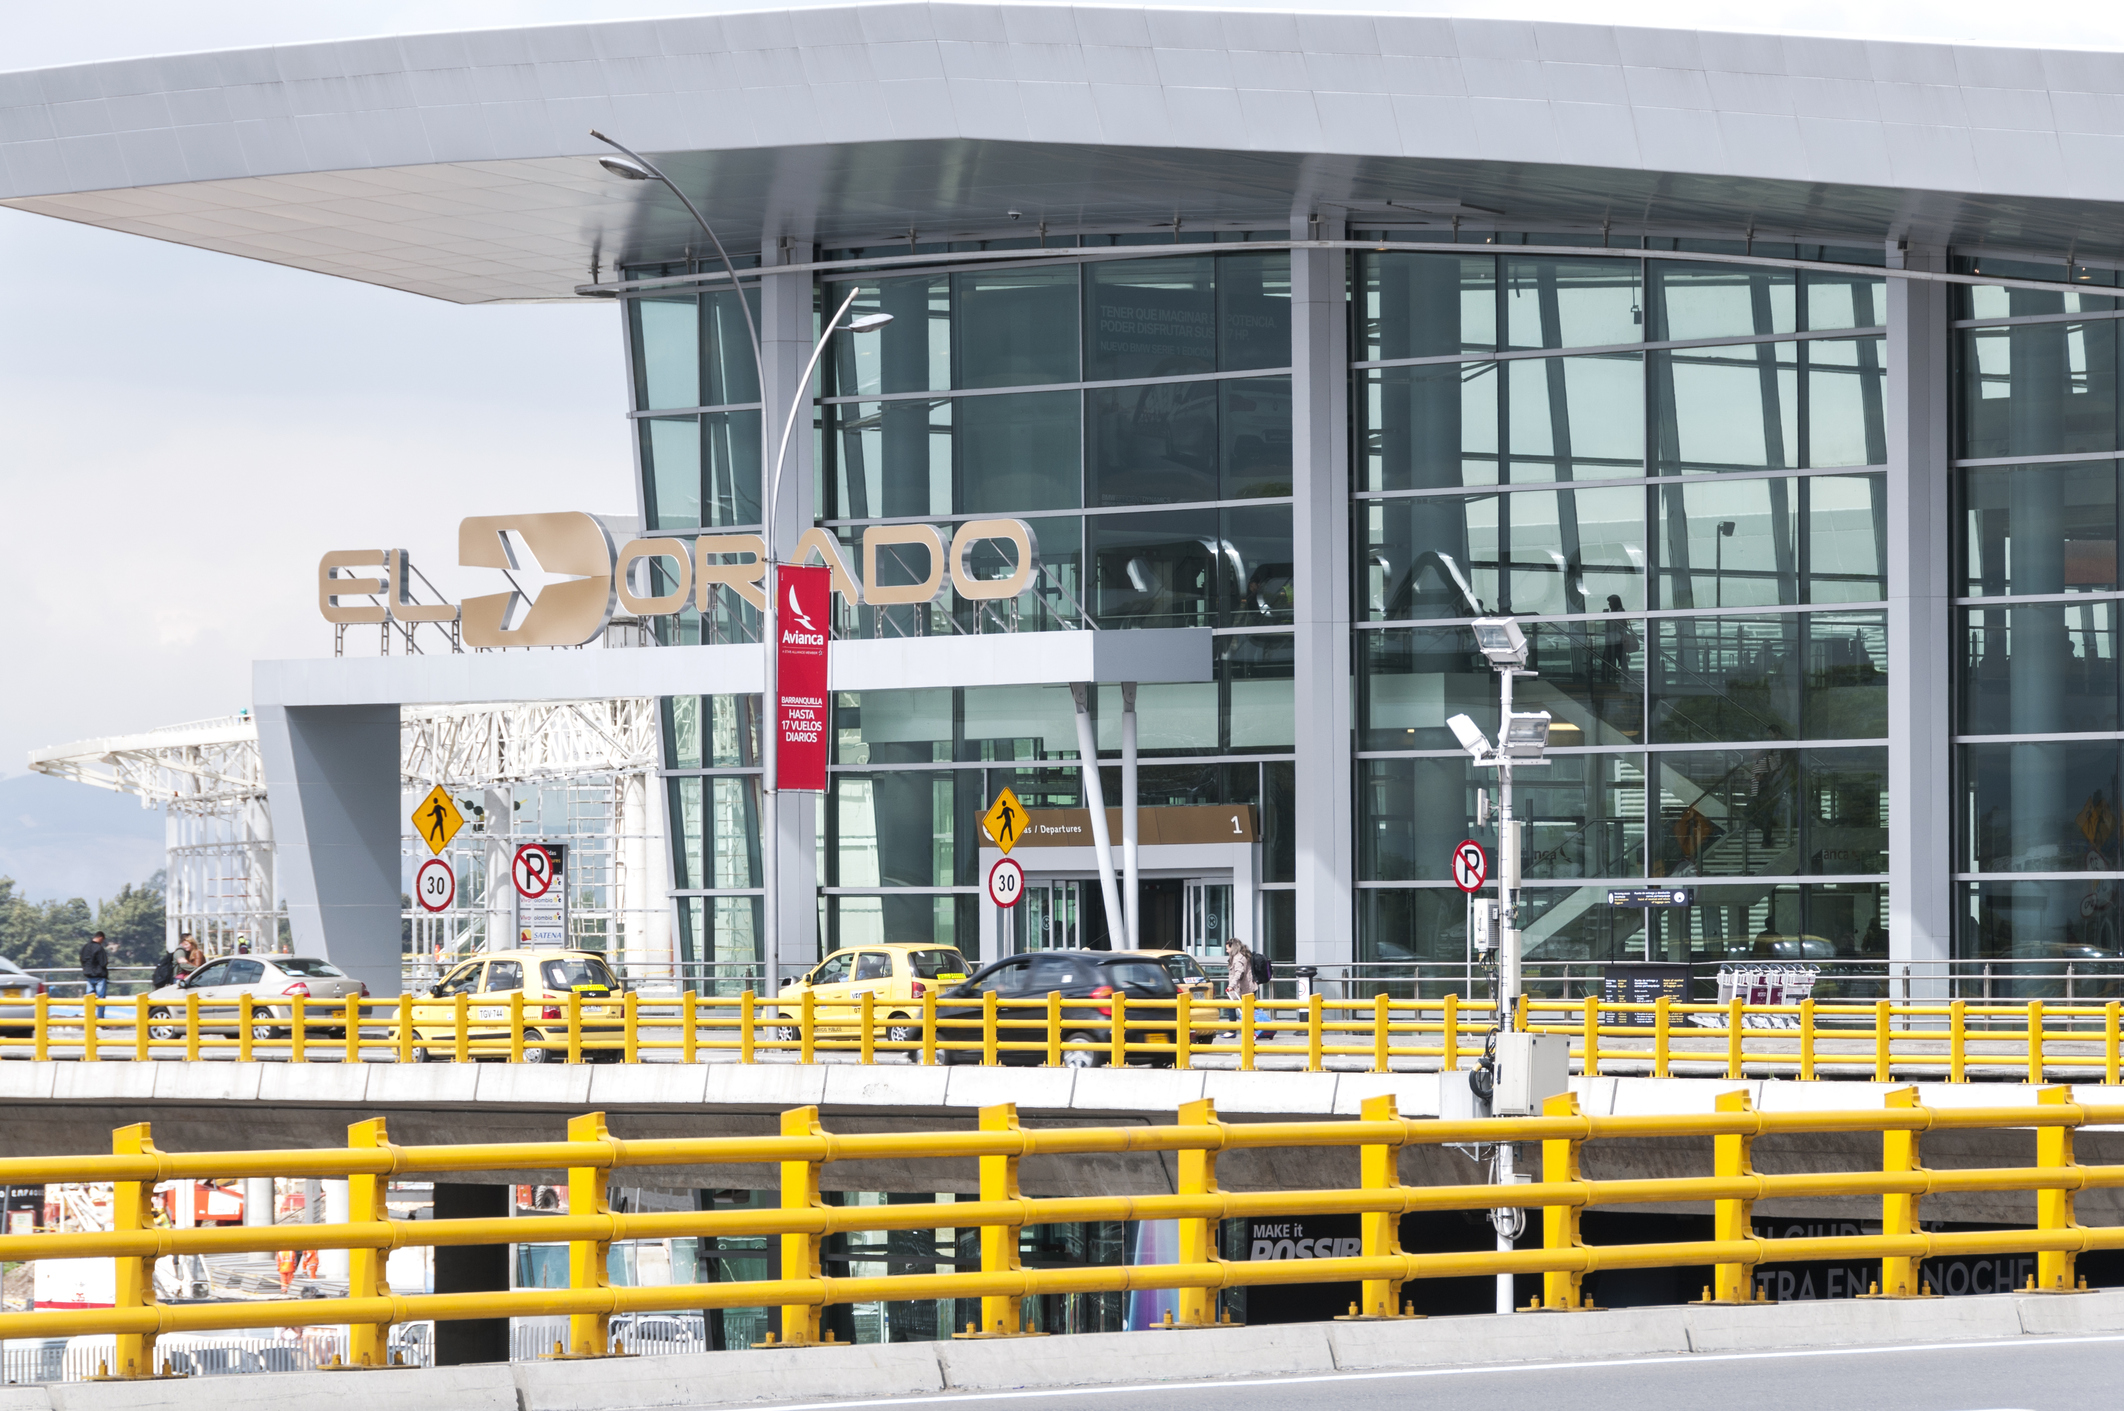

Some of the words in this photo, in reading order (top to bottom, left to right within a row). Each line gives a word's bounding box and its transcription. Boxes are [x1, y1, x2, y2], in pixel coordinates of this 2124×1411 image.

[1100, 305, 1134, 319] TENER
[1135, 307, 1158, 322] QUE
[1159, 309, 1208, 324] IMAGINAR
[1100, 320, 1136, 333] PODER
[1137, 322, 1193, 338] DISFRUTAR
[1194, 326, 1216, 339] SUS
[1100, 341, 1129, 352] NUEVO
[1129, 342, 1151, 353] BMW
[1151, 345, 1175, 355] SERIE
[318, 549, 459, 624] EL
[782, 629, 824, 645] Avianca
[781, 696, 823, 705] BARRANQUILLA
[789, 709, 815, 720] HASTA
[782, 720, 791, 730] 17
[791, 720, 823, 731] VUELOS
[786, 732, 818, 743] DIARIOS
[1040, 825, 1082, 836] Departures
[1230, 815, 1243, 834] 1
[427, 876, 445, 895] 30
[999, 874, 1015, 892] 30
[1253, 1224, 1290, 1238] MAKE
[1293, 1223, 1303, 1238] it
